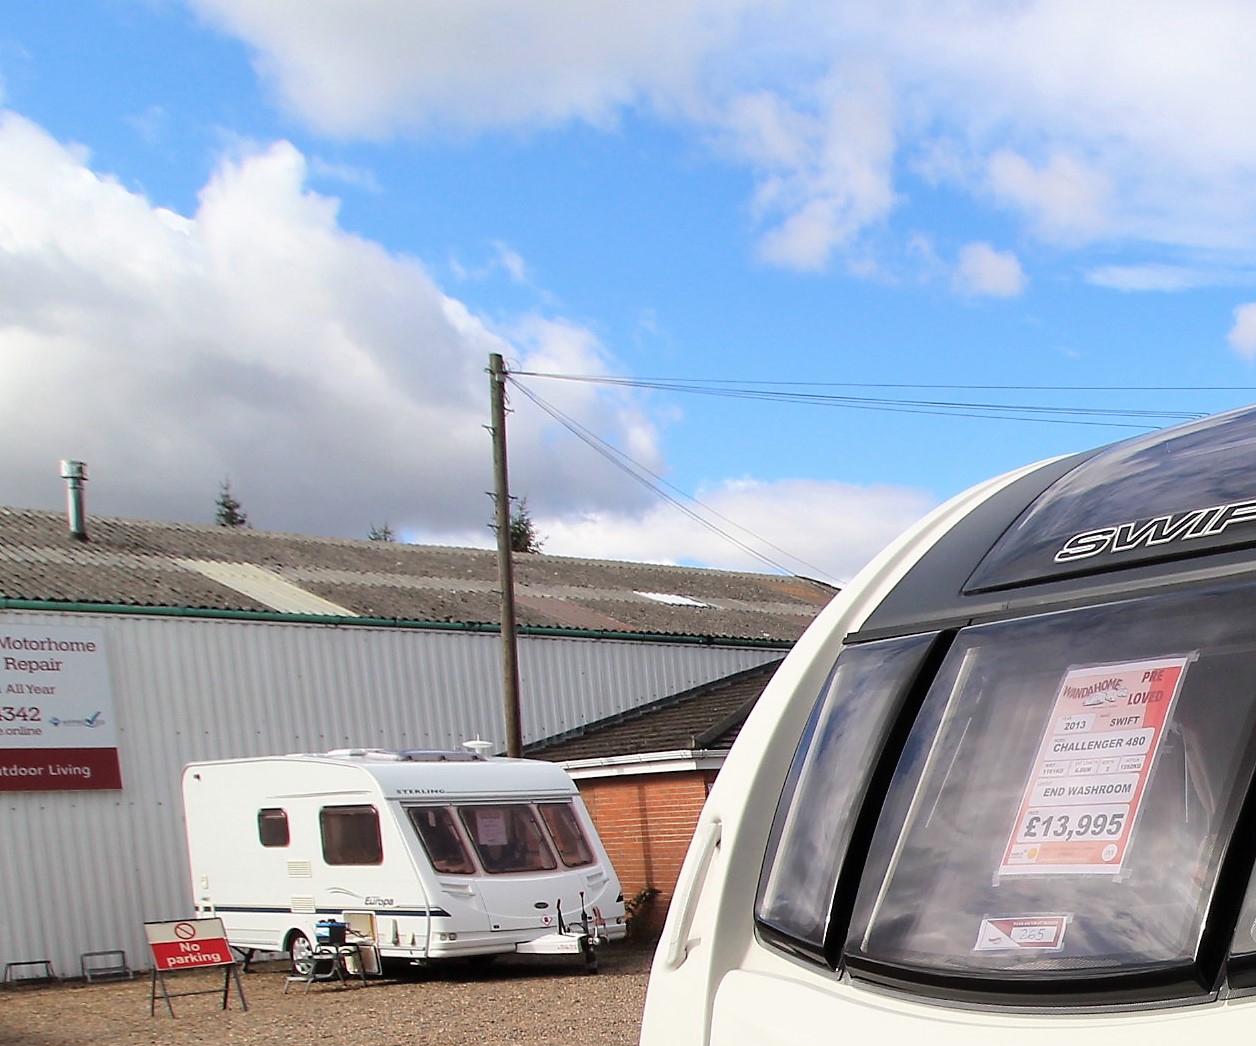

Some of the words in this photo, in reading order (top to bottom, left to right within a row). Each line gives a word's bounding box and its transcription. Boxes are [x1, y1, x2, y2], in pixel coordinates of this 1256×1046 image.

[4, 656, 62, 673] Repair
[1141, 670, 1164, 683] PRE
[6, 684, 23, 694] All
[26, 684, 56, 695] Year
[1063, 679, 1122, 699] WANDAHOME
[1127, 690, 1164, 706] LOVED
[1063, 721, 1087, 731] 2013
[1109, 716, 1141, 727] SWIFT
[1053, 738, 1123, 753] CHALLENGER
[1125, 736, 1146, 747] 480
[49, 764, 91, 778] Living
[1043, 787, 1065, 797] END
[1067, 783, 1132, 796] WASHROOM
[1024, 813, 1124, 841] £13,995
[1019, 928, 1046, 941] 265
[180, 942, 200, 953] No
[167, 952, 222, 967] parking
